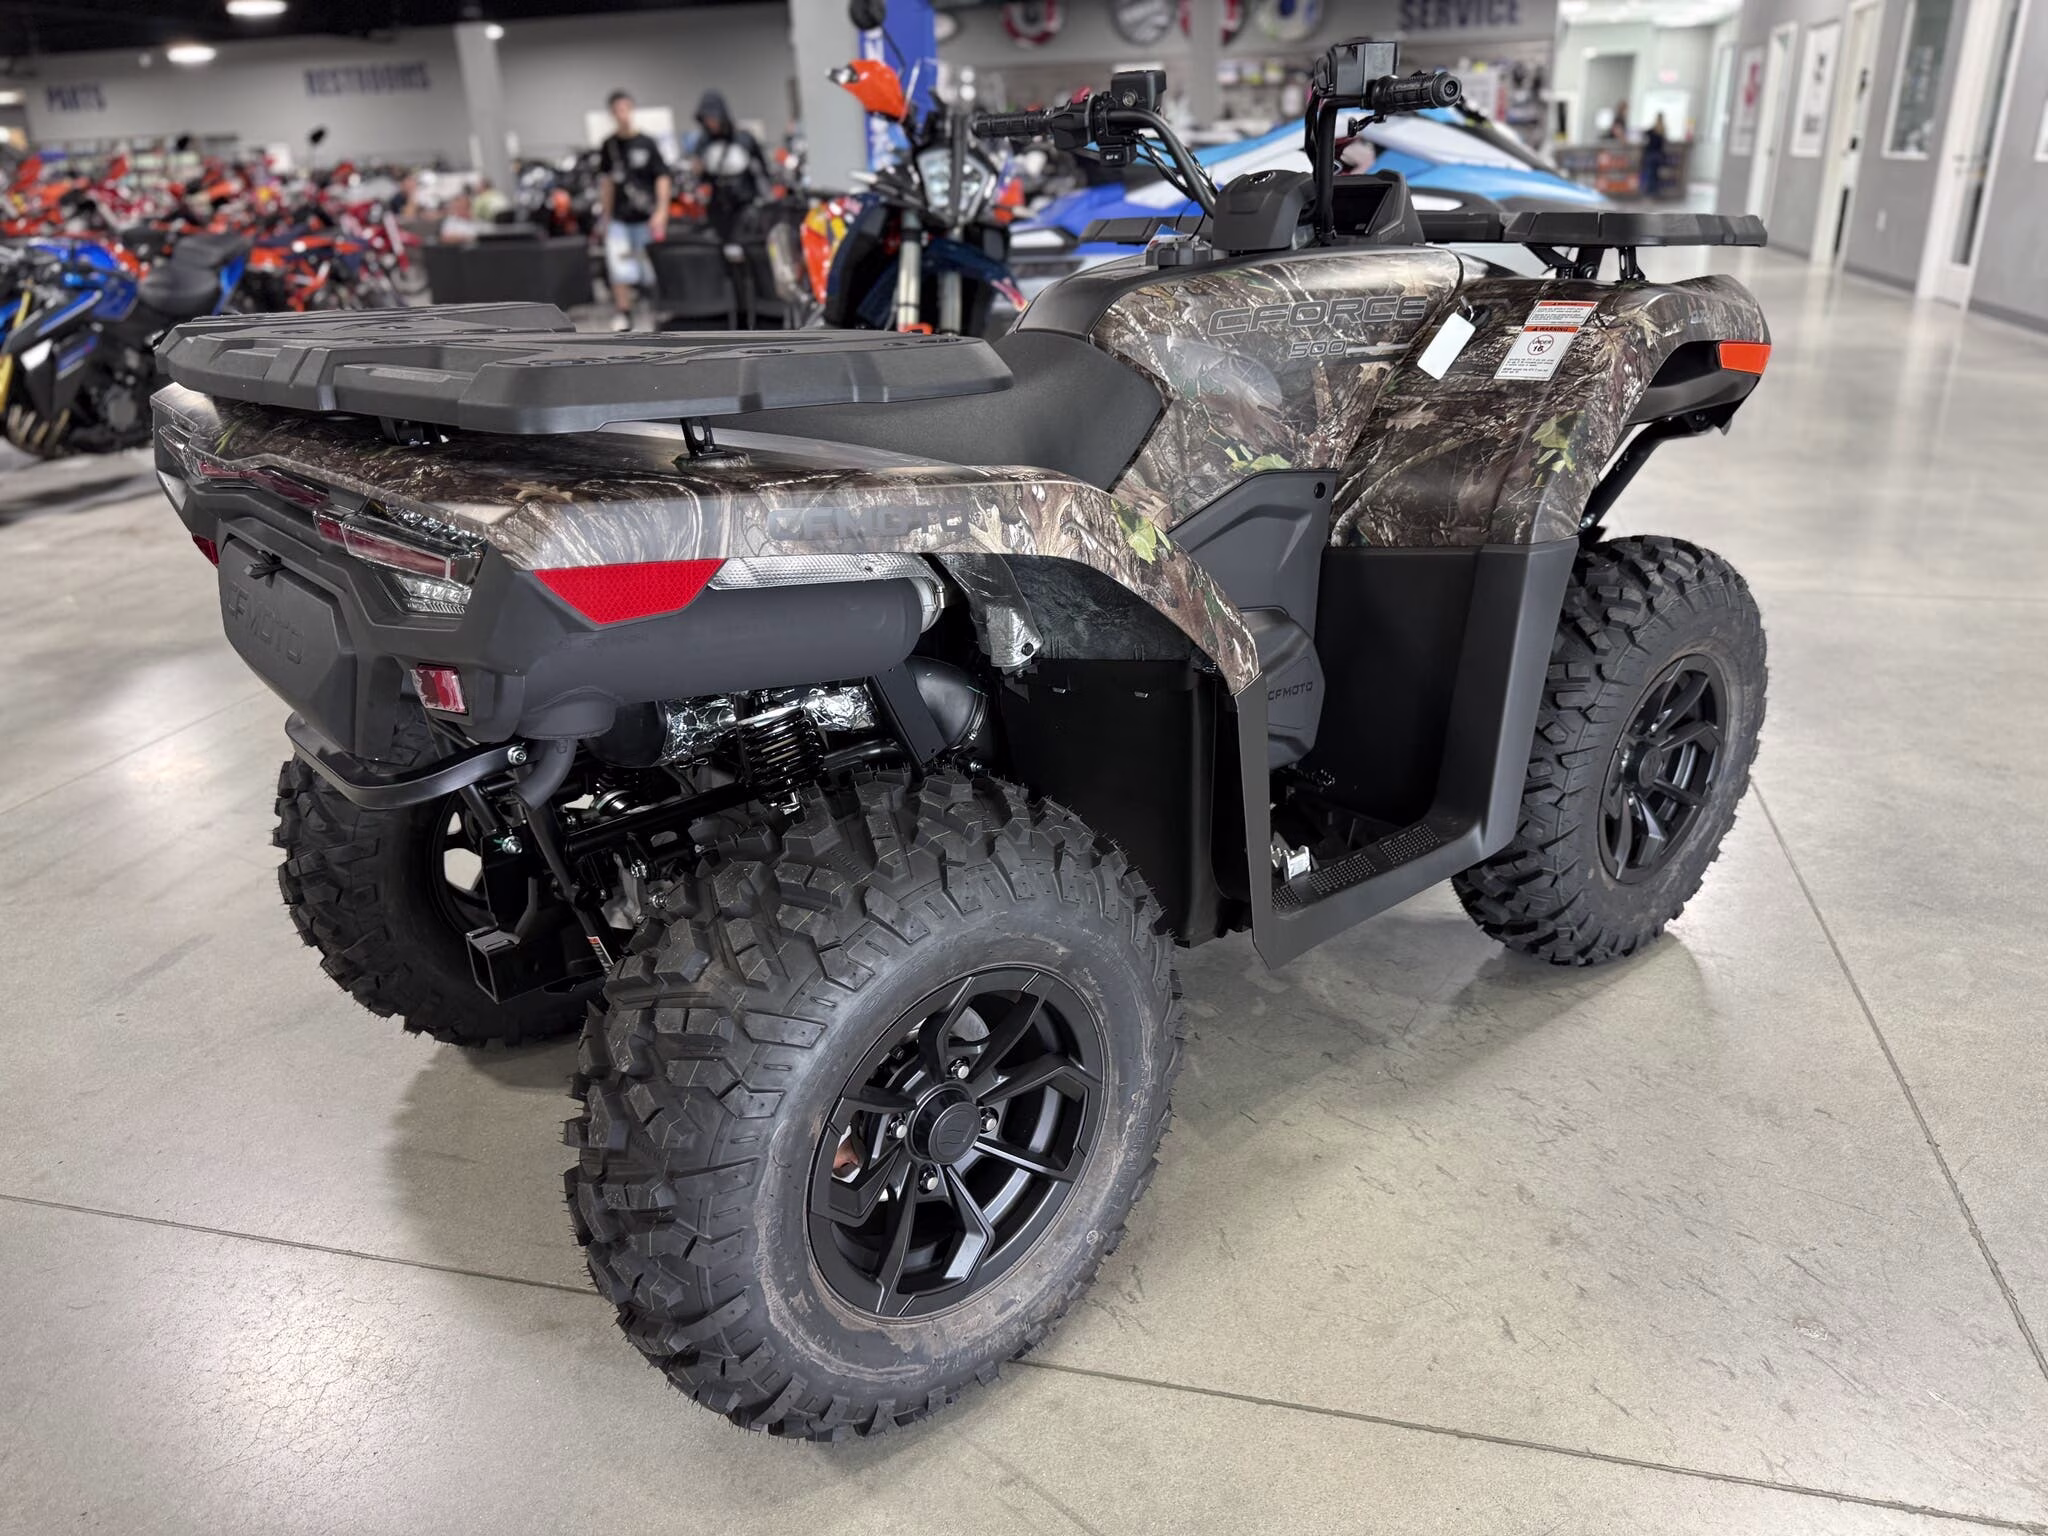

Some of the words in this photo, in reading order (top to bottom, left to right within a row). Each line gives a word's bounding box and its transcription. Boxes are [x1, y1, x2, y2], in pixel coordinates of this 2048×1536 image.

[1400, 0, 1520, 30] SERVICE
[46, 84, 106, 112] PARTS
[1207, 296, 1428, 337] CFORCE
[1287, 340, 1348, 359] 500
[768, 502, 969, 541] CFMOTO
[225, 581, 304, 665] CFMOTO
[1267, 681, 1313, 701] CFMOTO
